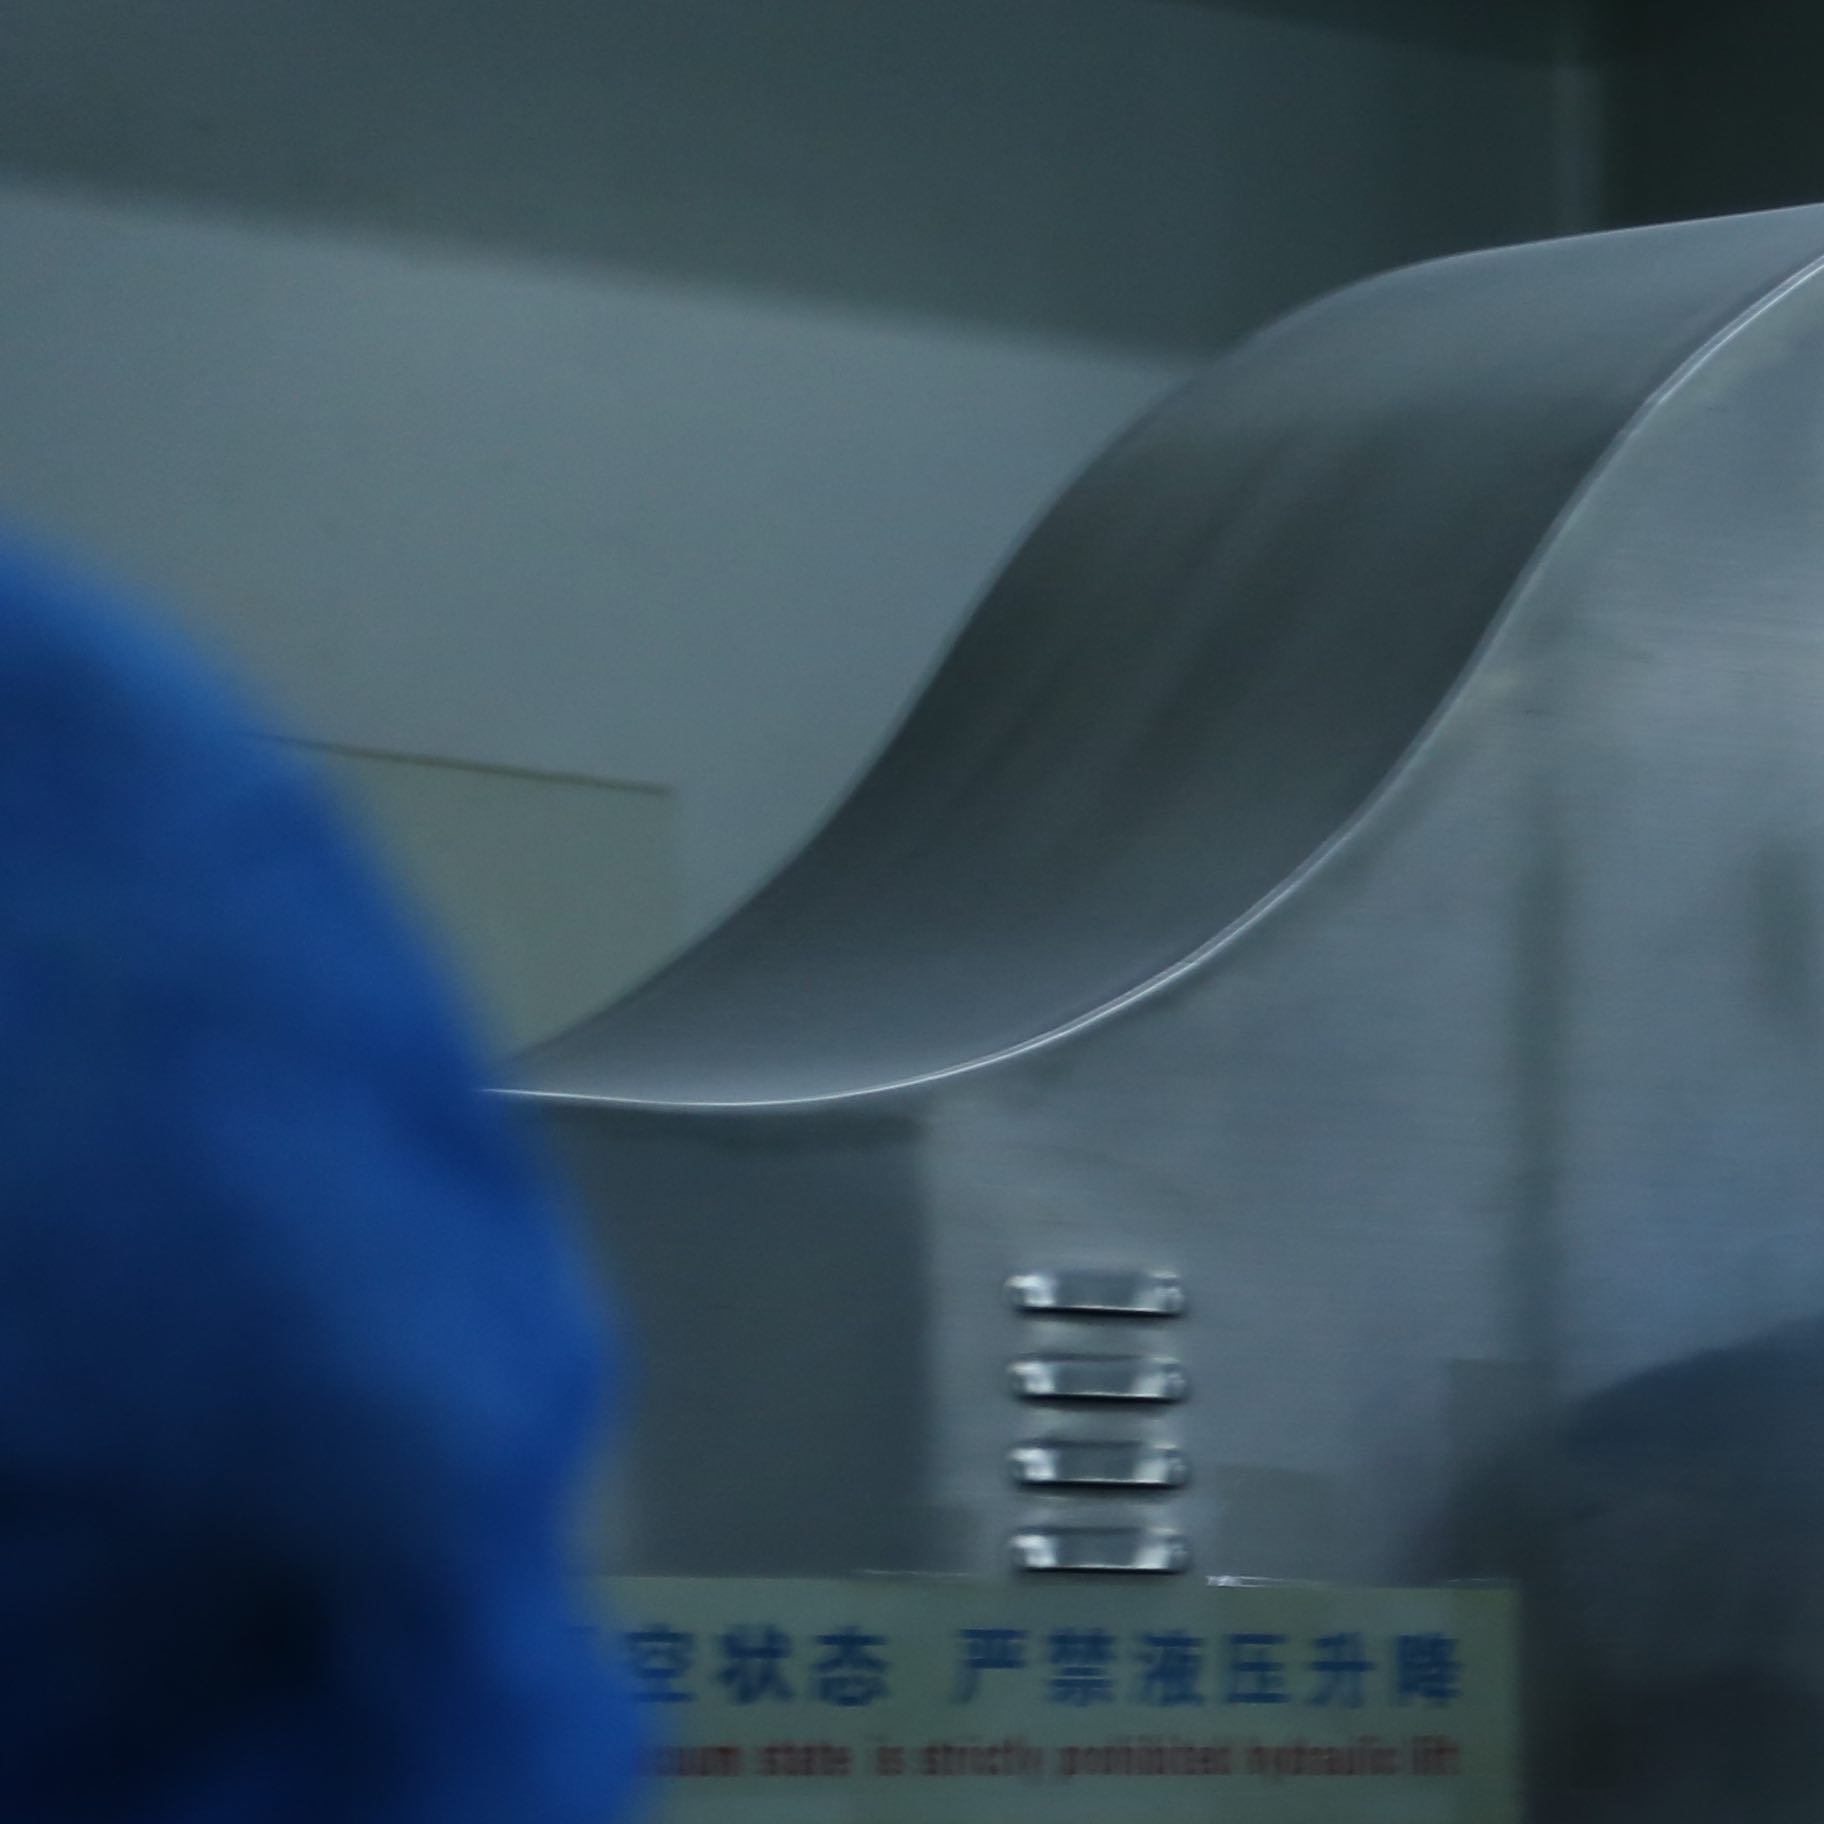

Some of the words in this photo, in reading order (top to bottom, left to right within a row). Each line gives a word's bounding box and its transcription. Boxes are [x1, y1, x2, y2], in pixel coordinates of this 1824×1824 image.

[952, 1624, 1464, 1708] 严禁液压升降
[758, 1738, 852, 1777] state
[874, 1737, 906, 1777] is
[922, 1734, 1045, 1788] strictly
[1056, 1733, 1232, 1787] prohibited
